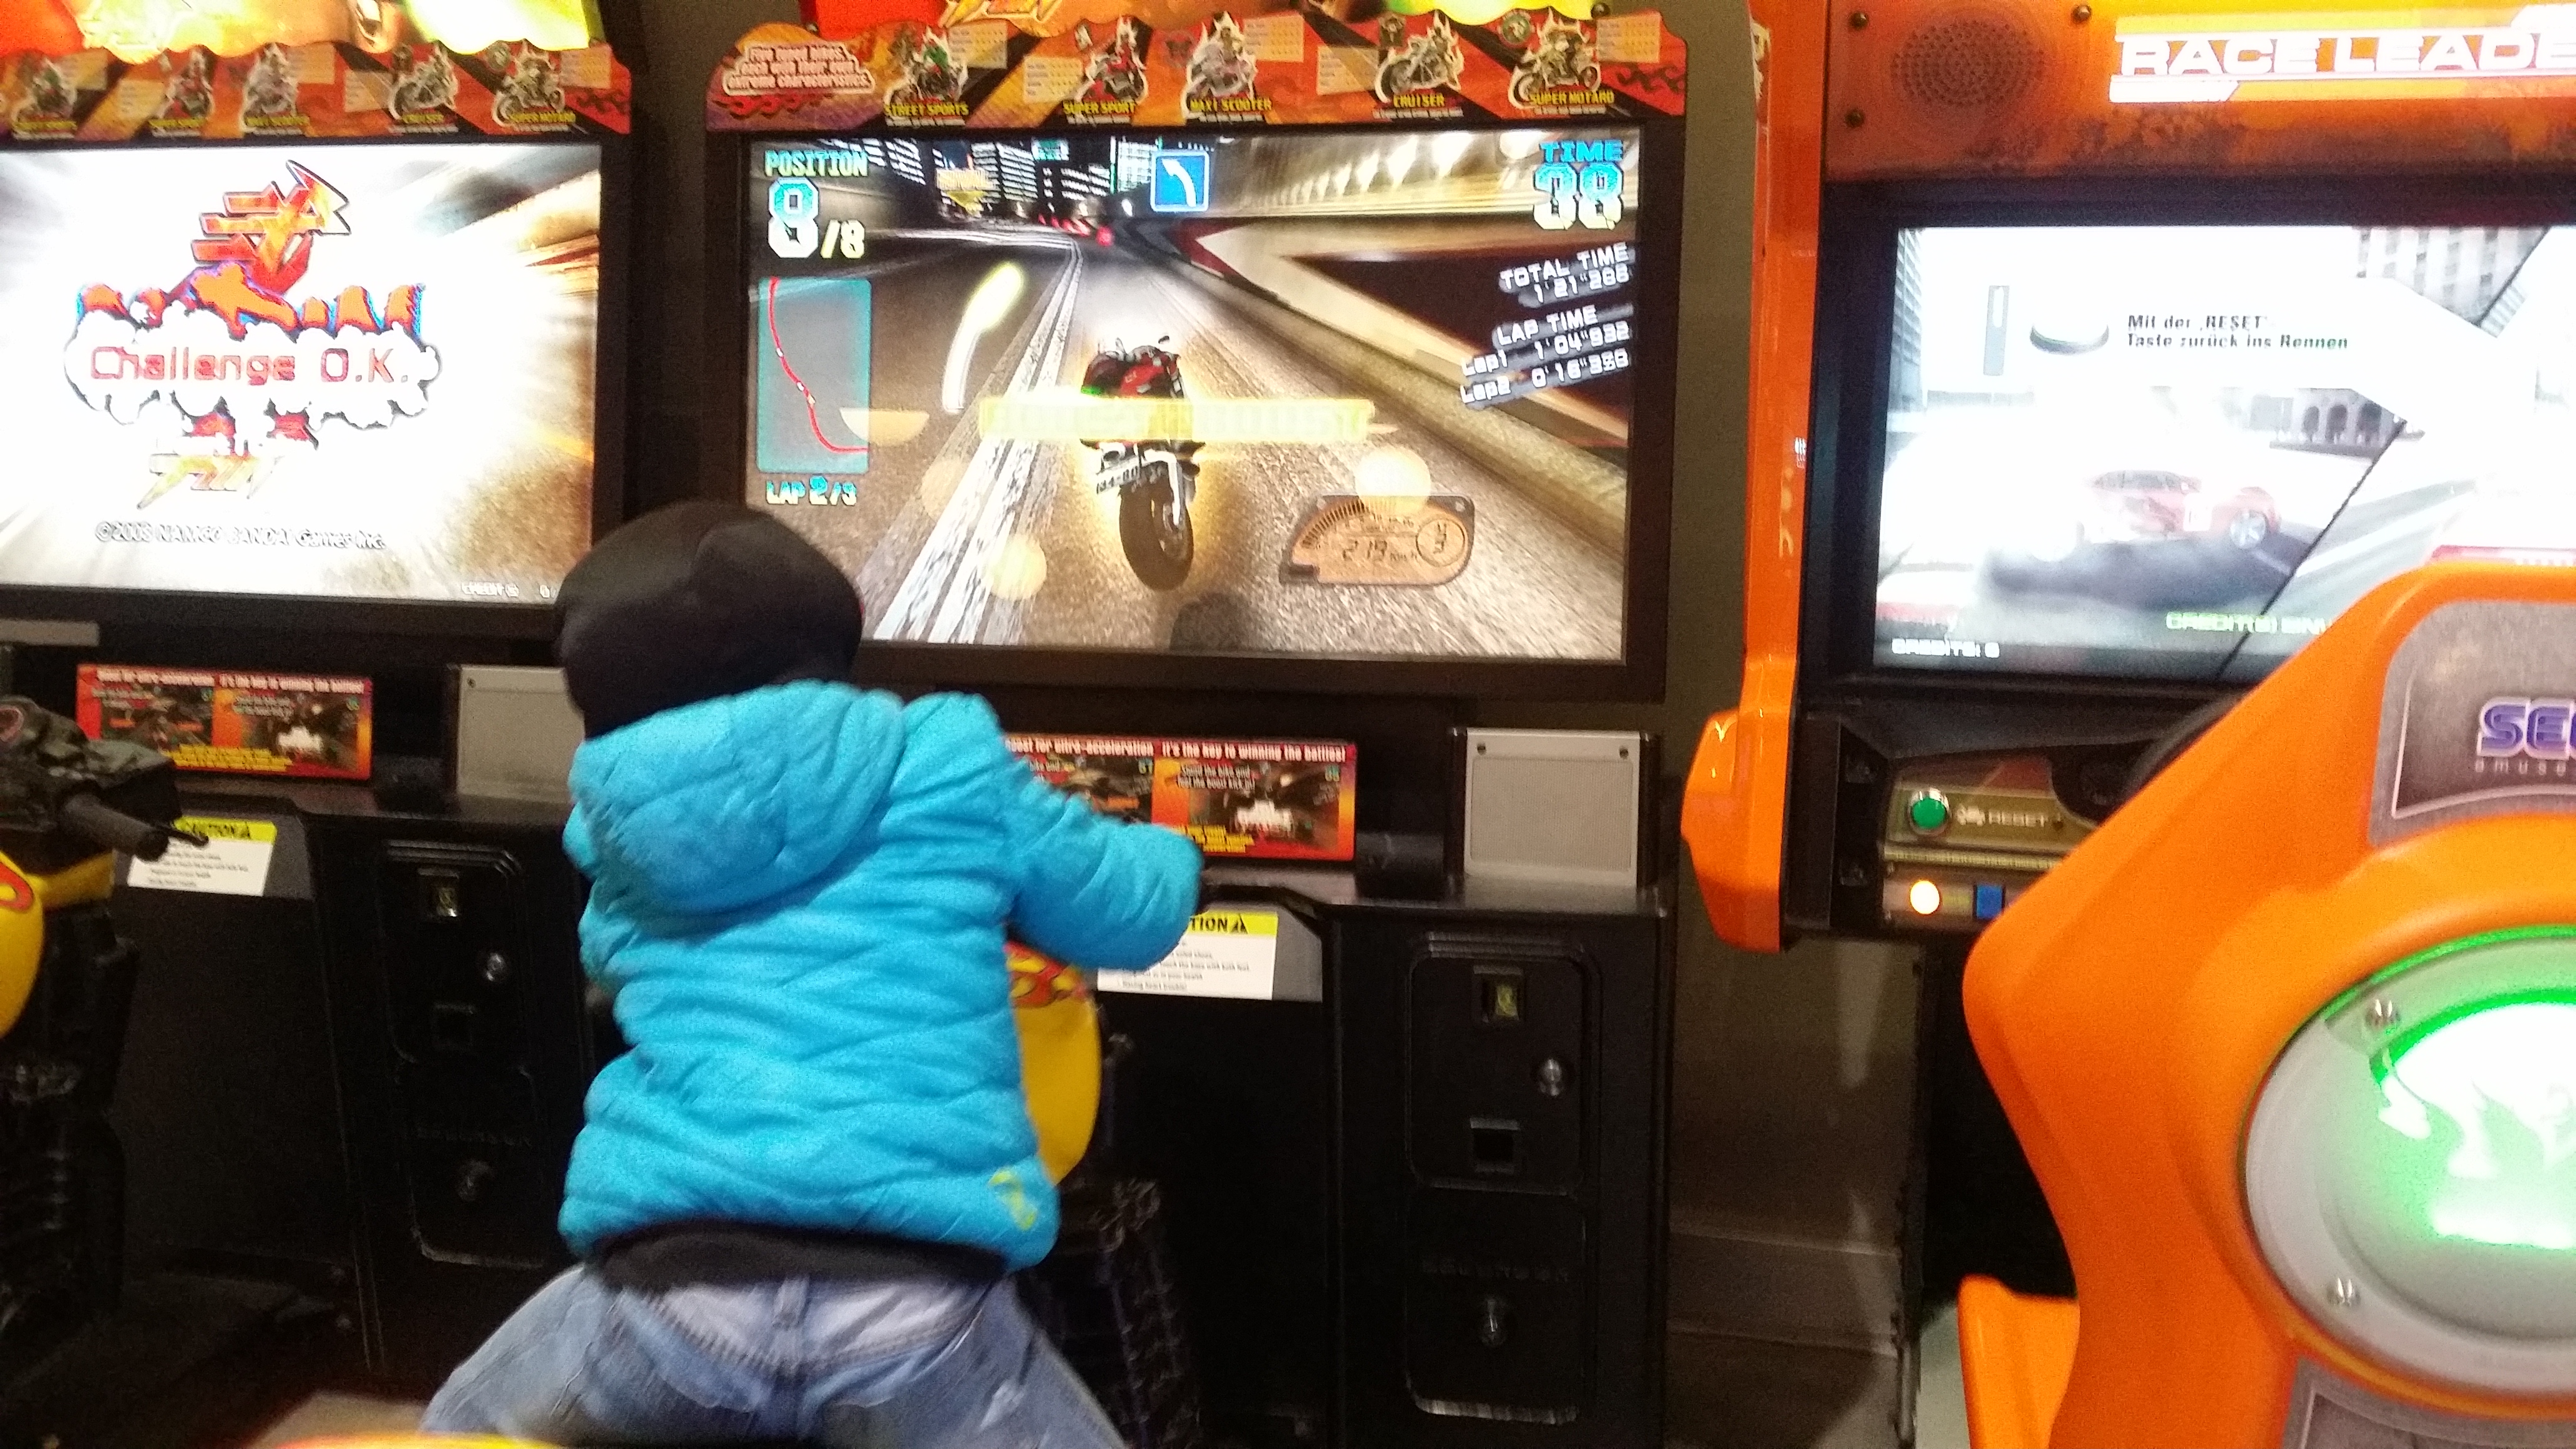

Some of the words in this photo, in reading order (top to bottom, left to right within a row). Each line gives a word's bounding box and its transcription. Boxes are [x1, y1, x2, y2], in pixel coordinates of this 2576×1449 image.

[2120, 39, 2318, 75] RACE
[1062, 100, 1100, 115] SUPER
[1101, 100, 1136, 115] SPORT
[1189, 98, 1217, 112] MAXI
[1220, 97, 1272, 112] SCOOTER
[1393, 92, 1445, 107] CRUISER
[1529, 92, 1567, 105] SUPER
[1568, 90, 1615, 104] MOTARD
[884, 102, 924, 117] STREET
[926, 102, 969, 117] SPORTS
[1539, 139, 1623, 162] TIME
[764, 150, 869, 177] POSITION
[1500, 258, 1571, 290] TOTAL
[1577, 241, 1629, 270] TIME
[1497, 318, 1539, 346] LAP
[1546, 305, 1599, 333] TIME
[2128, 315, 2156, 329] Mit
[2164, 315, 2191, 329] der
[2128, 333, 2173, 348] Taste
[2180, 333, 2238, 348] zurück
[2247, 334, 2272, 348] ins
[2280, 334, 2348, 349] Rennen
[90, 346, 296, 386] Challenge
[320, 347, 409, 383] O.K.
[766, 480, 806, 505] LAP
[156, 524, 223, 544] NAMCO
[228, 526, 291, 546] BANDAI
[2476, 696, 2576, 761] SE
[1181, 741, 1201, 758] the
[1202, 742, 1222, 760] key
[1237, 743, 1282, 762] winning
[1284, 743, 1302, 761] the
[1190, 917, 1229, 933] TION
